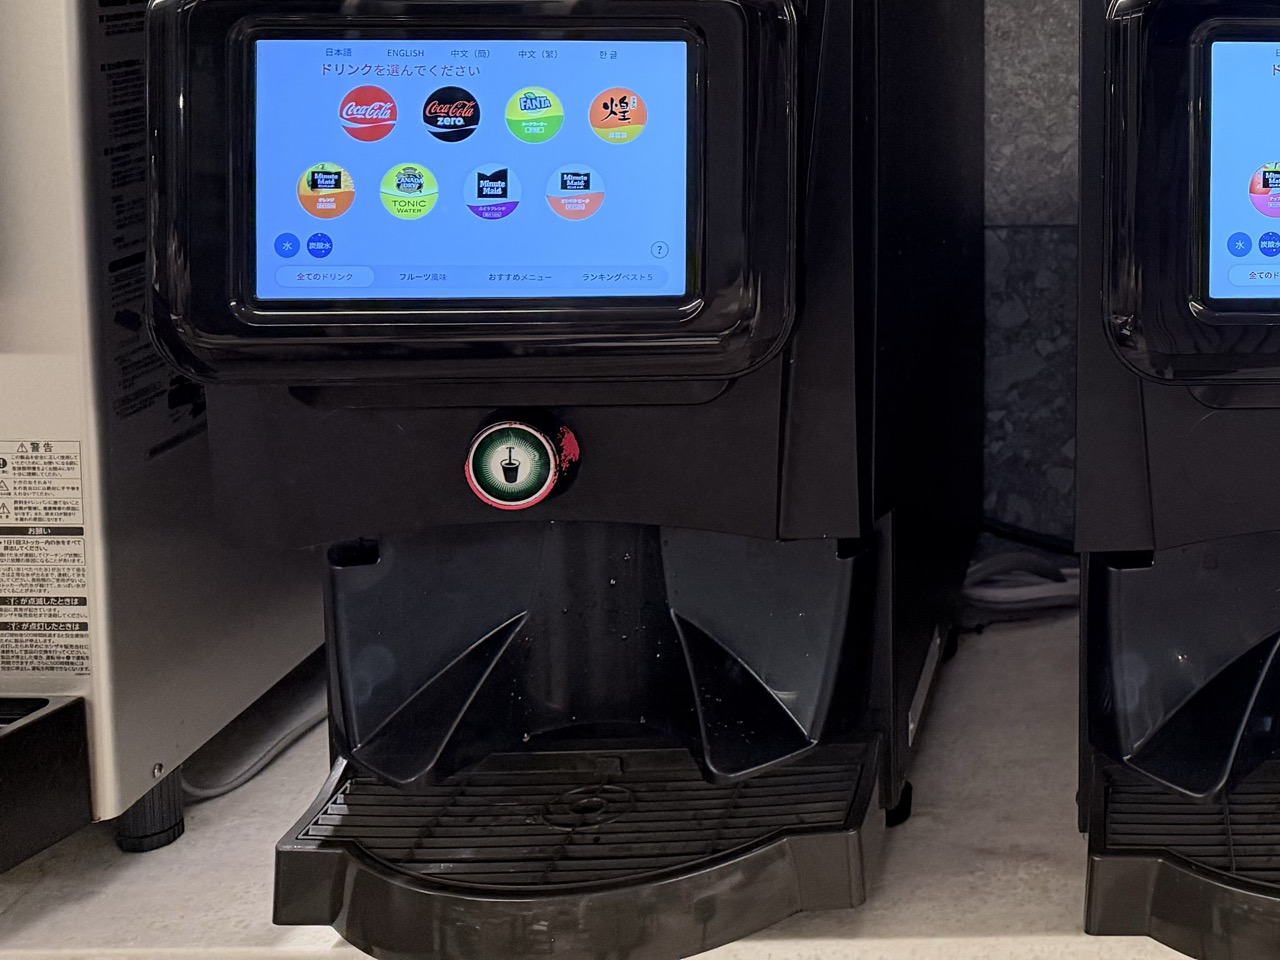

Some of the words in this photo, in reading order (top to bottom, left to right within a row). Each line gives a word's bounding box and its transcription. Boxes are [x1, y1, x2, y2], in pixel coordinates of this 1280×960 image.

[325, 48, 352, 57] 日本語
[387, 49, 424, 57] ENGLISH
[321, 63, 480, 77] ドリンクを選んでください
[342, 101, 395, 119] Coca-Cola
[425, 100, 476, 117] Coca-Cola
[601, 95, 631, 121] 煌
[437, 117, 464, 126] zero
[282, 241, 293, 251] 水
[1235, 240, 1245, 250] 水
[296, 273, 353, 281] 全てのドリンク
[400, 273, 447, 281] フルーツ風味
[488, 273, 552, 281] おすすめメニュー
[30, 442, 54, 453] 警告
[28, 527, 51, 535] お願い
